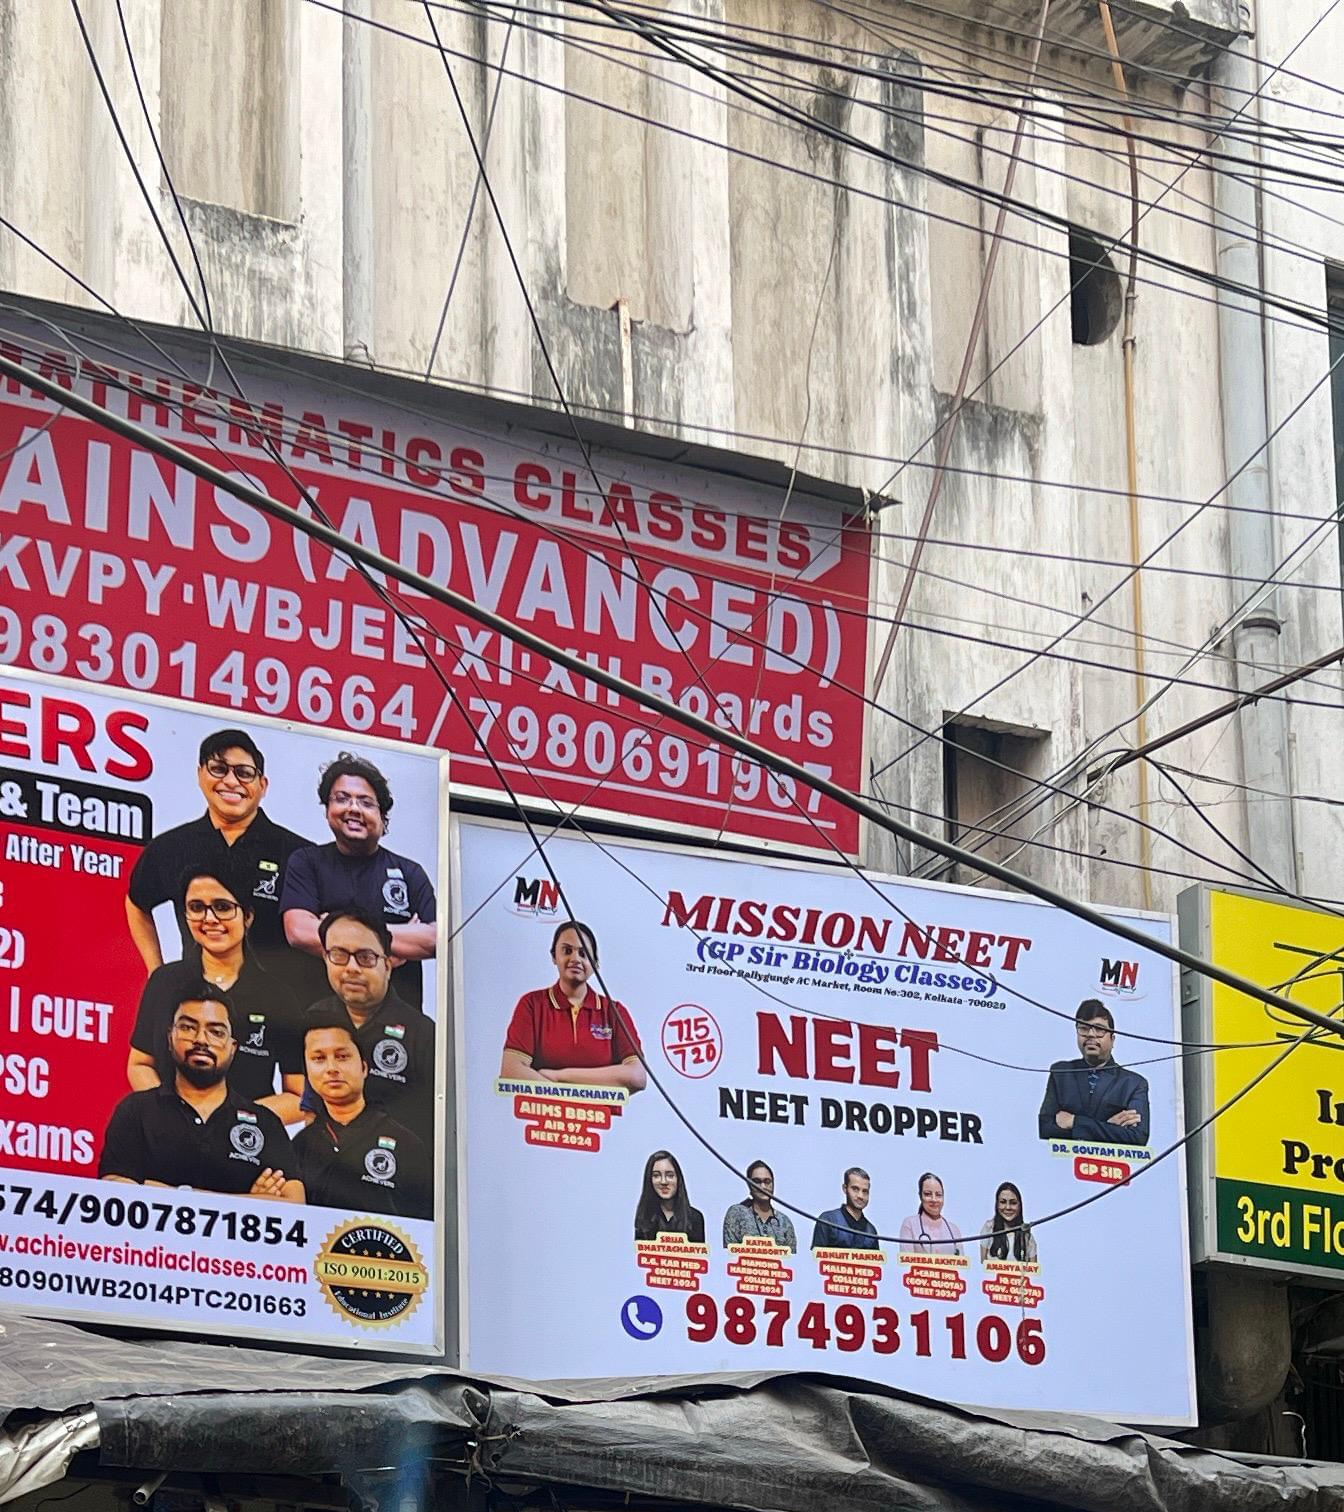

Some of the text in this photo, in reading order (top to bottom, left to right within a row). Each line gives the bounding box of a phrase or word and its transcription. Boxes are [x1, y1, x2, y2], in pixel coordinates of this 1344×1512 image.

[514, 462, 812, 569] CLASSES
[292, 484, 843, 688] (ADVANCED)
[640, 664, 834, 748] Boards
[0, 780, 29, 819] &
[35, 785, 145, 840] Team
[661, 889, 1032, 972] MISSION NEET
[793, 949, 890, 985] Biology
[894, 964, 999, 999] Classes)
[668, 1016, 709, 1043] 715
[756, 1010, 939, 1093] NEET
[673, 1044, 717, 1073] 720
[718, 1087, 984, 1144] NEET DROPPER
[1072, 1145, 1115, 1157] GOUTAM
[1118, 1148, 1151, 1160] PATRA
[1079, 1162, 1123, 1180] GP SIR
[341, 1228, 405, 1255] CERTIFIED
[1237, 1196, 1292, 1249] 3rd
[323, 1262, 420, 1285] ISO 9001:2015
[686, 1294, 1046, 1366] 9874931106
